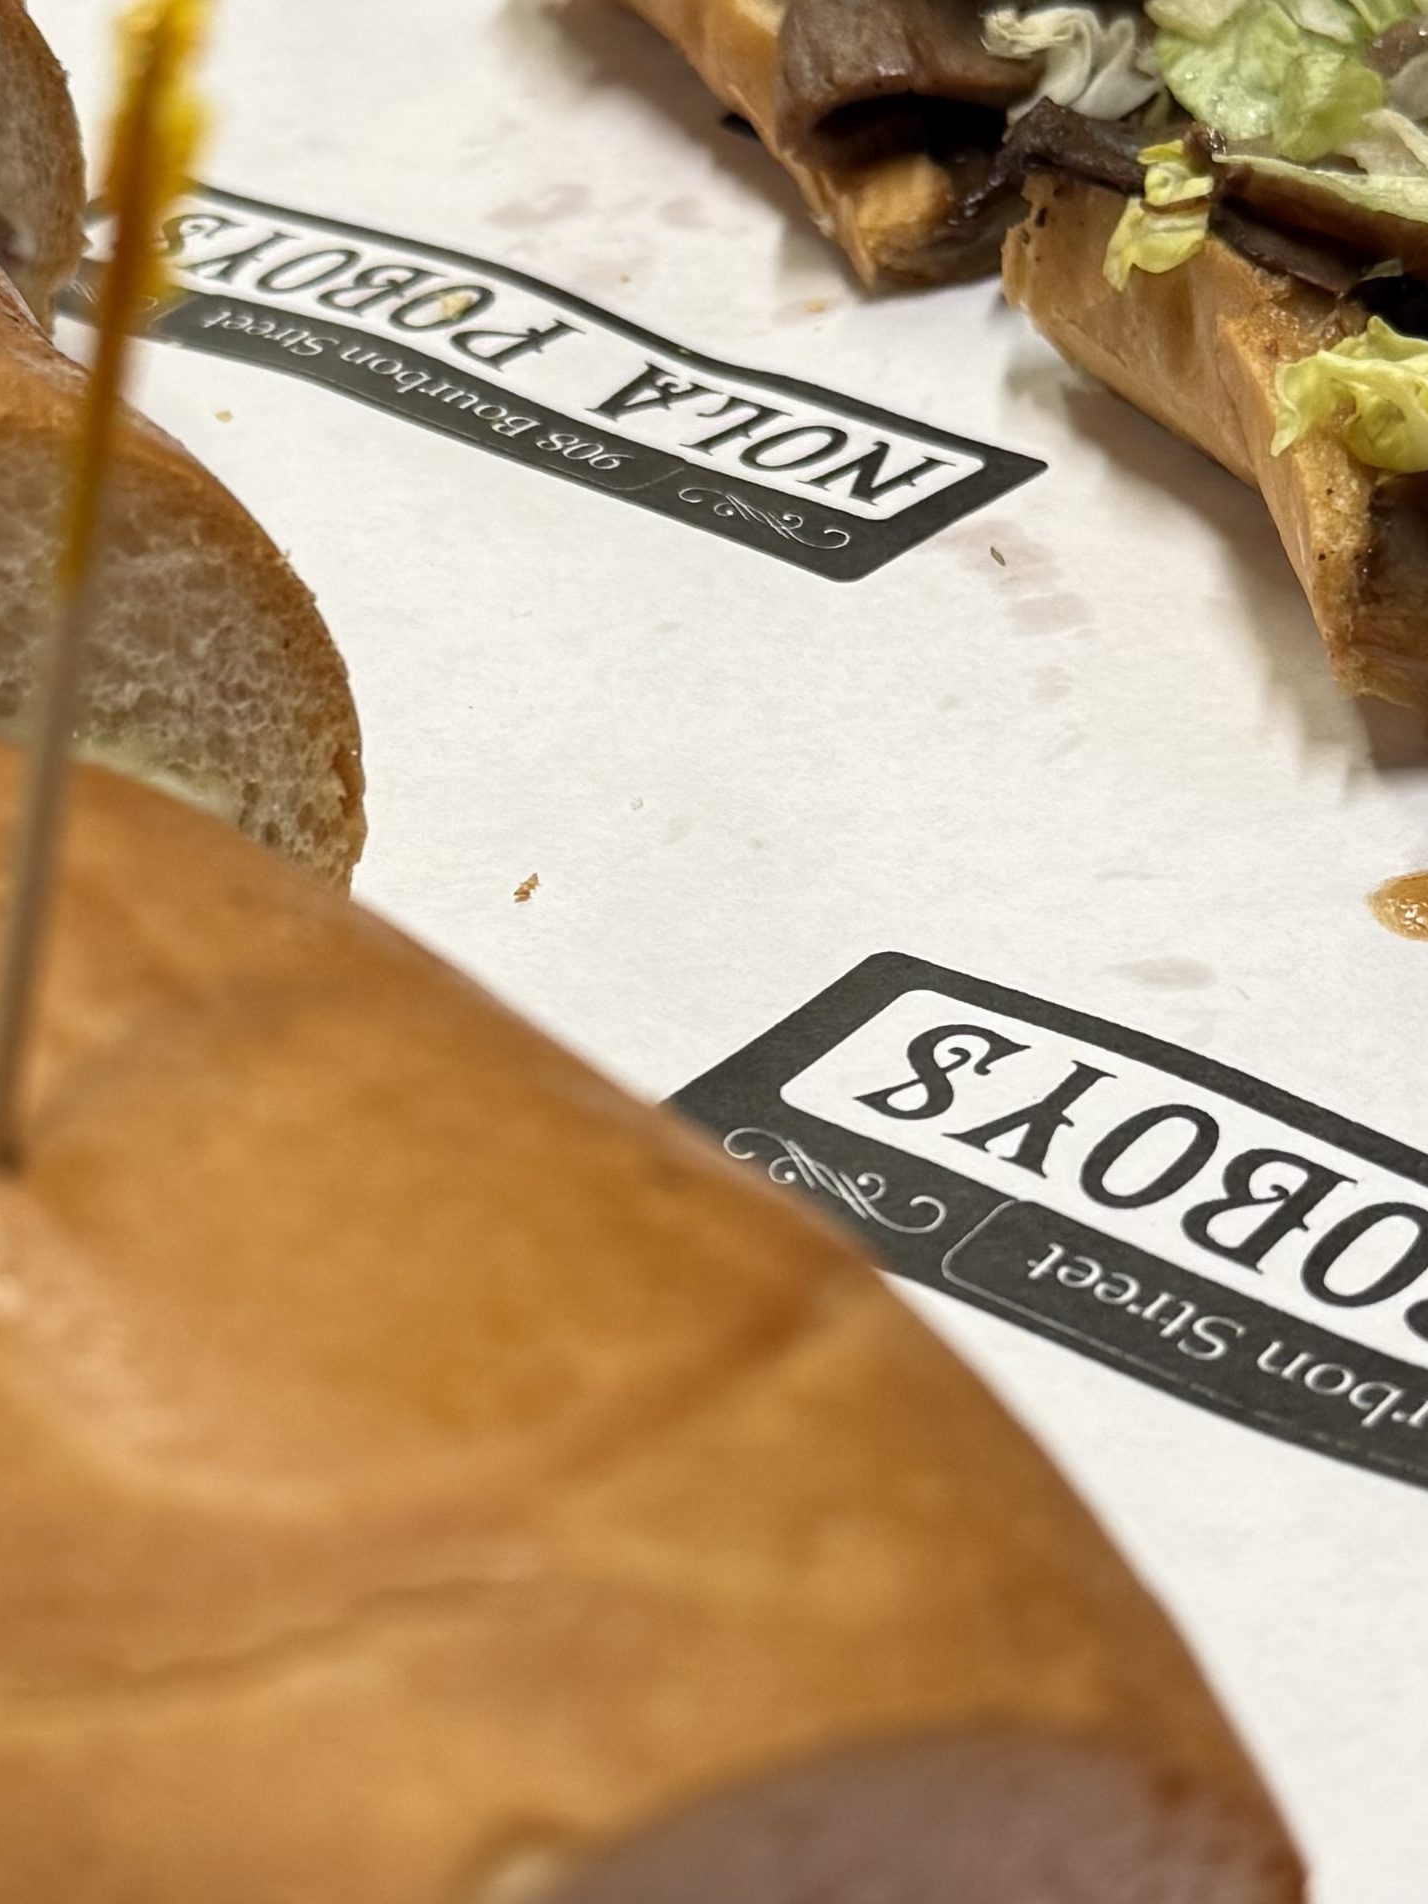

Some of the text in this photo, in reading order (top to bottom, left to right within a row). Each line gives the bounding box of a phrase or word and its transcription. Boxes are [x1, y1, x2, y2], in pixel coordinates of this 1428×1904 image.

[158, 208, 960, 507] NOLA POBOYS
[198, 301, 636, 474] 908 Bourbon Street
[1027, 1241, 1248, 1364] Street
